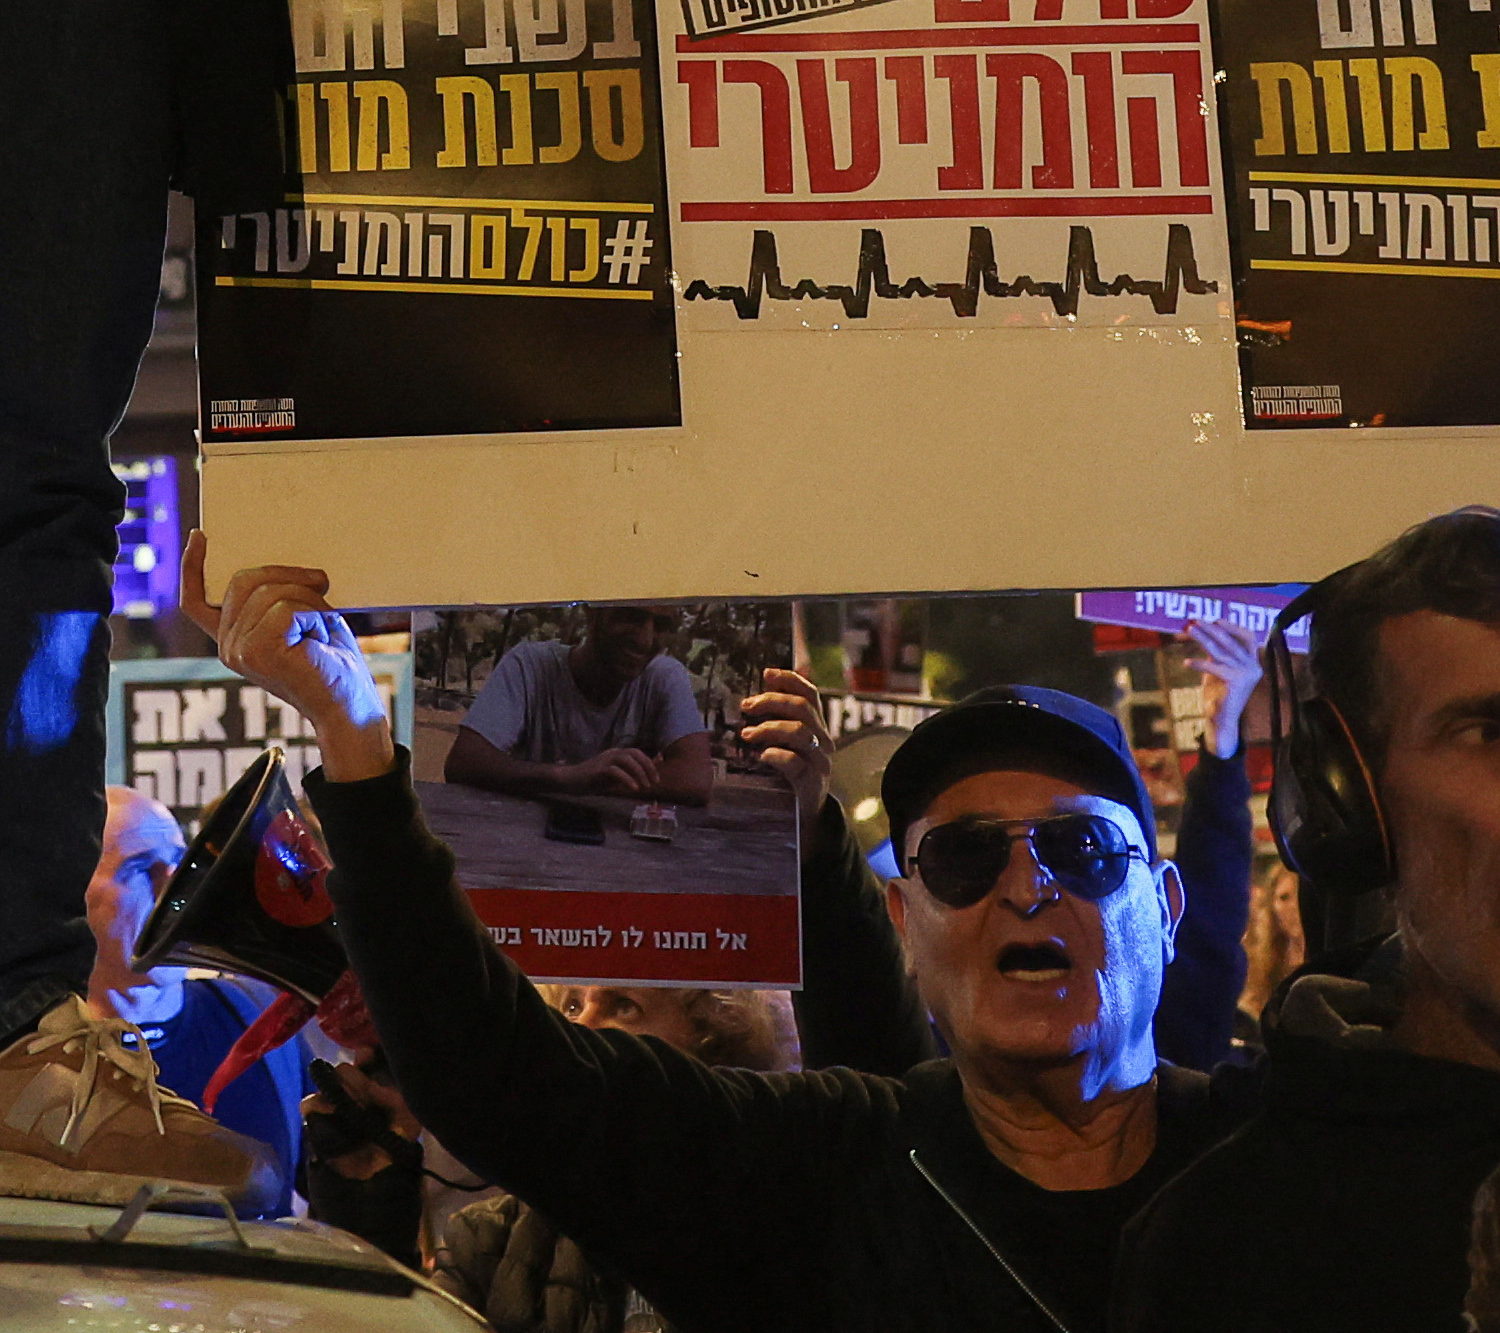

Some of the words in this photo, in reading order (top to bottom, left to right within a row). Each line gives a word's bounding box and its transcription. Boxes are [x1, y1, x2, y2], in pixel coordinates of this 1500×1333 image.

[288, 79, 411, 174] מוו
[435, 68, 645, 169] סכנת
[678, 49, 1210, 194] הומניטרי
[1250, 57, 1450, 156] מוות
[1135, 591, 1222, 623] עכשיו!
[133, 687, 229, 744] את
[530, 924, 613, 948] להשאר
[621, 925, 644, 949] לו
[653, 931, 707, 950] תתנו
[716, 927, 748, 951] אל
